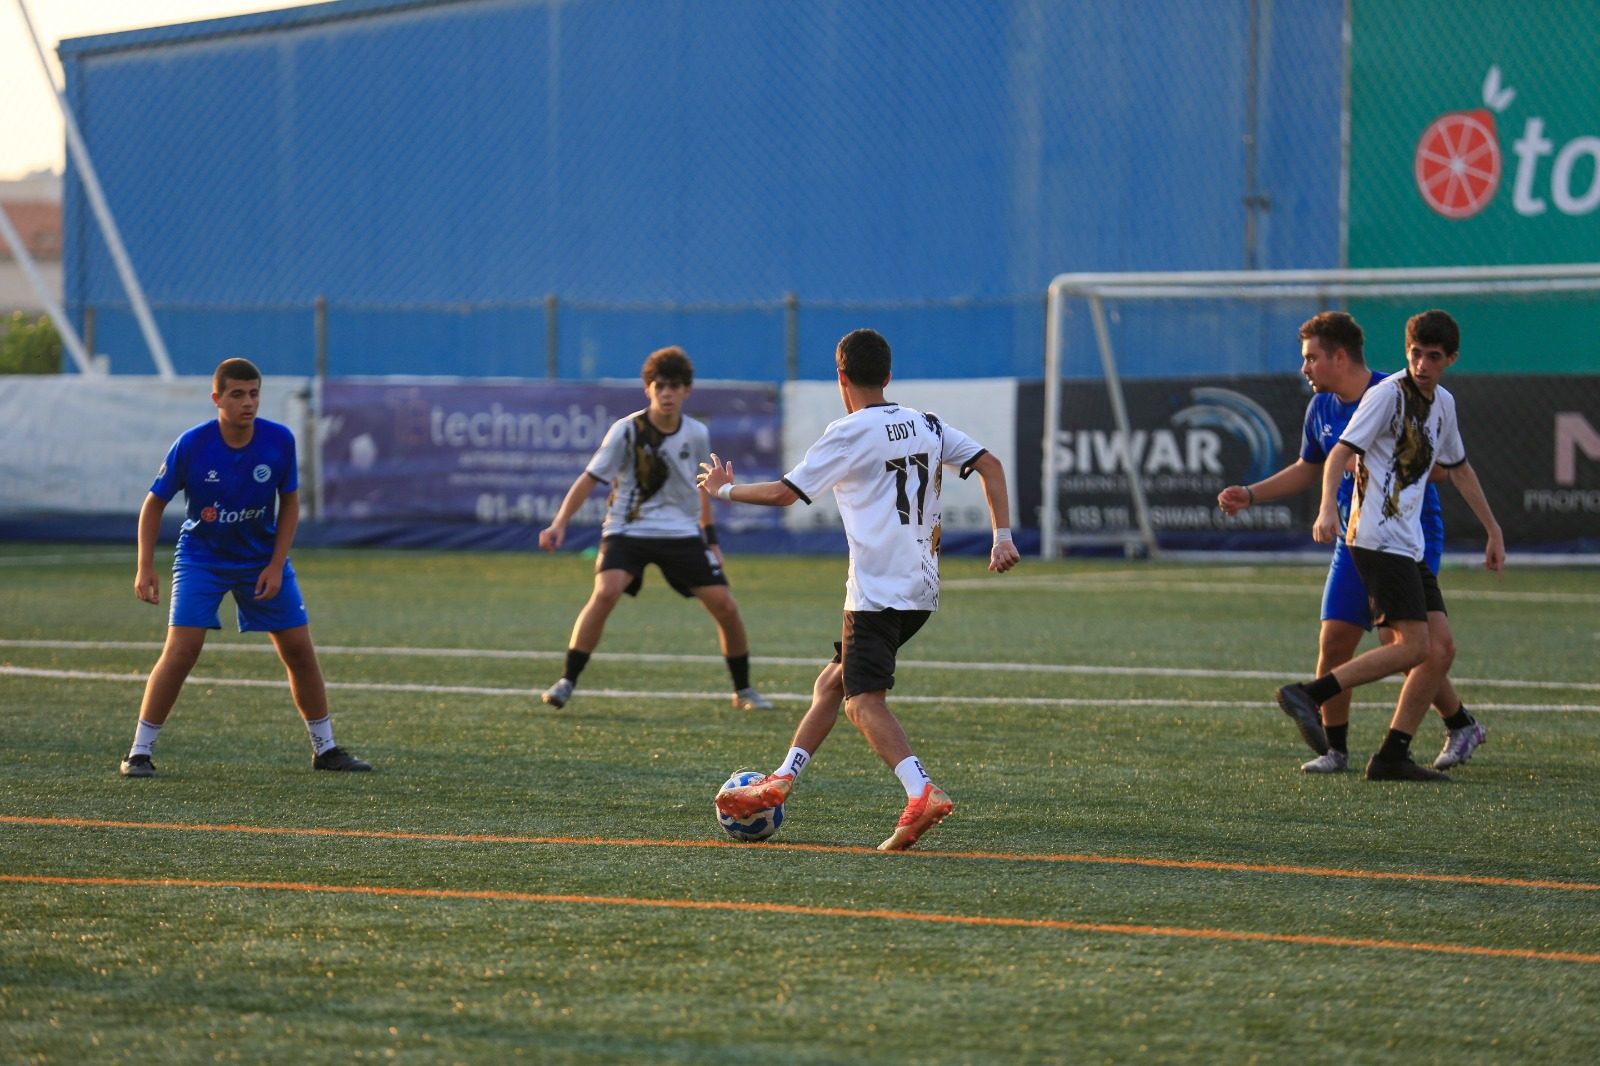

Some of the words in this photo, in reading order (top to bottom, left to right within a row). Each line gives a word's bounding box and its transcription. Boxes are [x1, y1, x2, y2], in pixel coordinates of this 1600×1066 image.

[1512, 116, 1600, 216] to
[430, 402, 615, 449] technobl
[885, 419, 917, 442] EDDY
[1045, 429, 1223, 474] SIWAR
